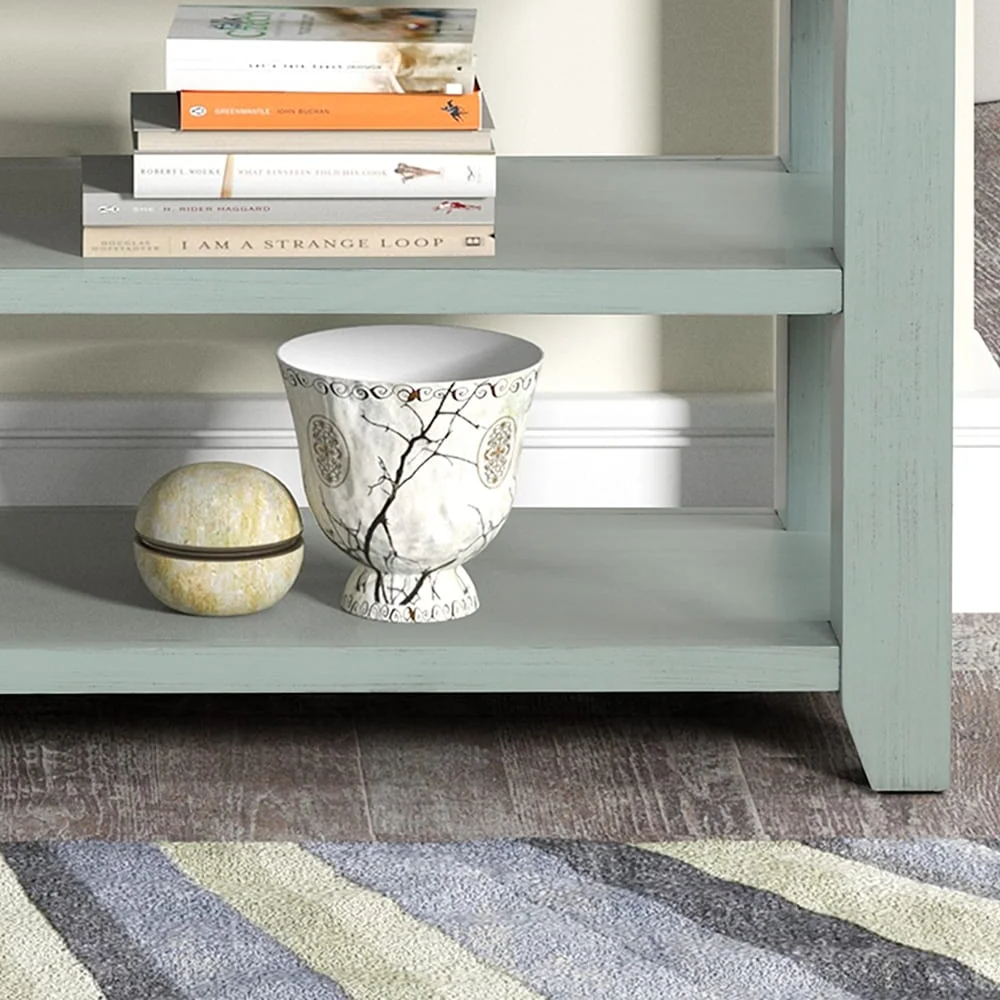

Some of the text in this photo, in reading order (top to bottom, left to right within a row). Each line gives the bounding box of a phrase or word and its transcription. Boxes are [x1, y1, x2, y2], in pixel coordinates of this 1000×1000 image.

[181, 237, 445, 250] I AM A STRANGE LOOP
